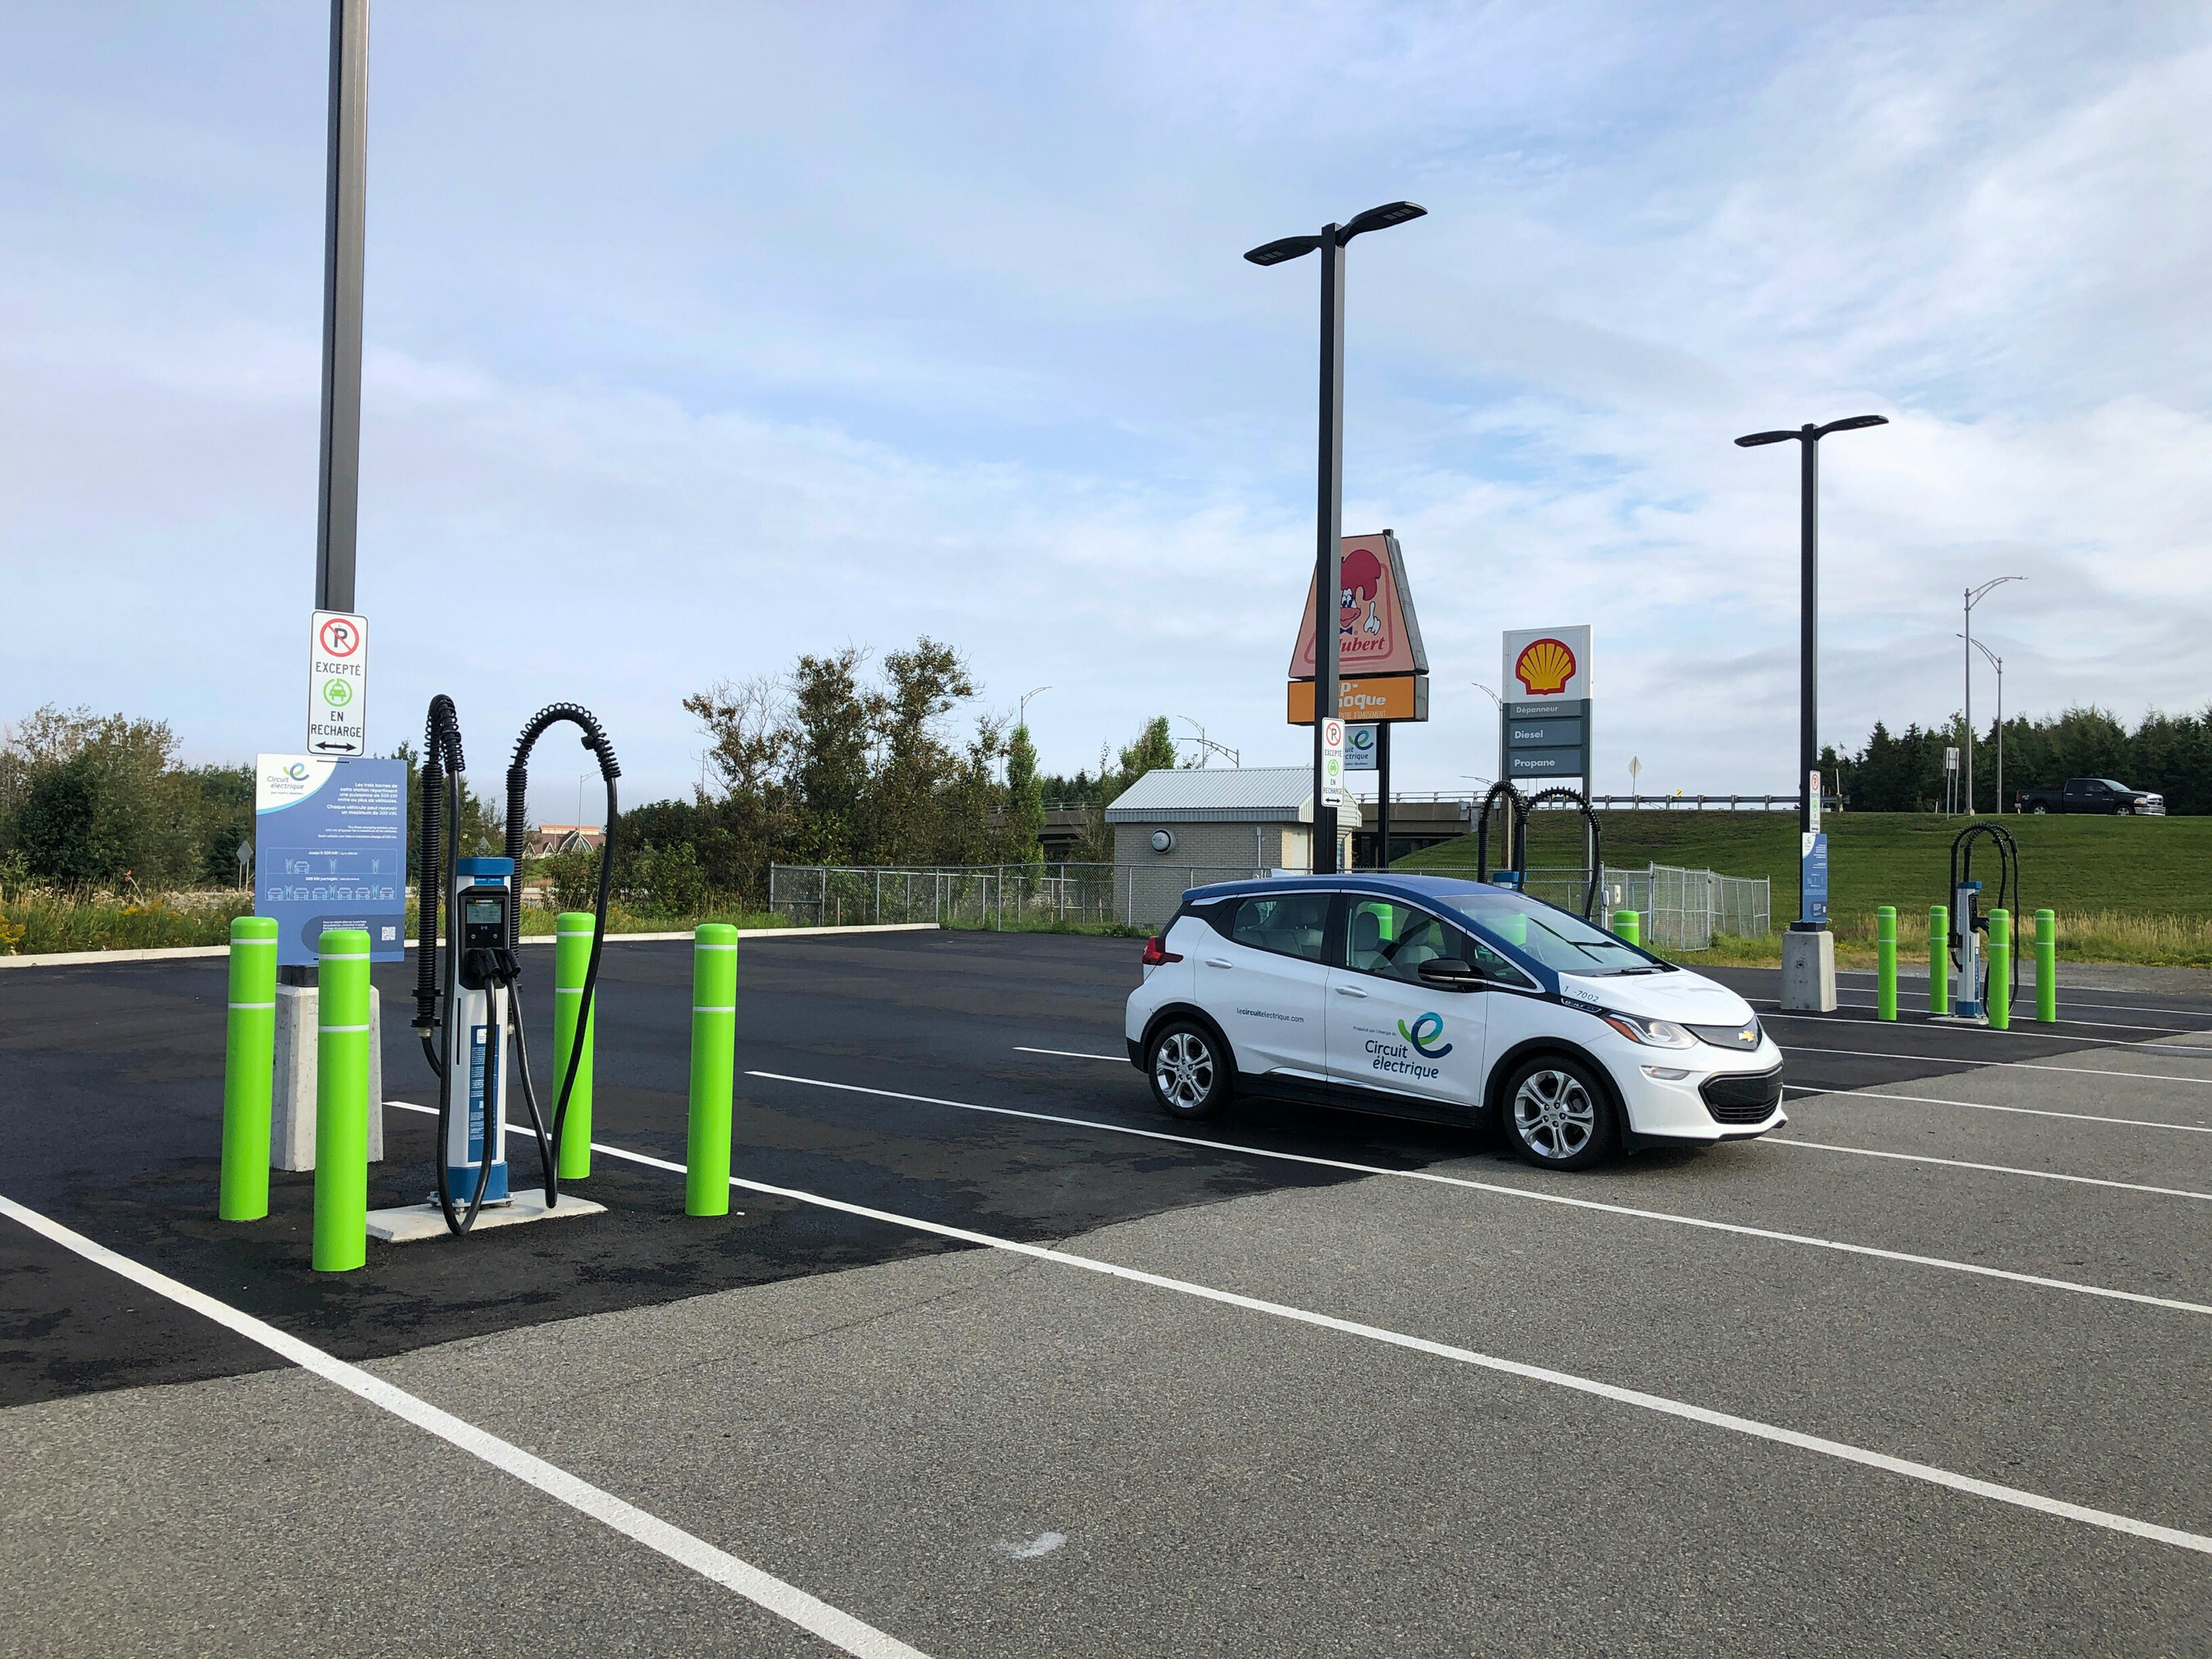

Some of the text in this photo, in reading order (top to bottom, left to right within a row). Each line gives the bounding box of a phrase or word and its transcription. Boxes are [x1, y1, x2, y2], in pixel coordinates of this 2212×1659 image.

[1339, 637, 1385, 652] ubert
[315, 661, 361, 676] EXCEPTÉ
[330, 710, 344, 722] EN
[1516, 706, 1559, 715] Dépanneur
[310, 724, 362, 737] RECHARGE
[1514, 729, 1543, 739] Diesel
[1514, 759, 1556, 769] Propane
[1236, 1007, 1304, 1022] lecircuitelectrique.com
[1365, 1040, 1408, 1058] Circuit
[1372, 1055, 1439, 1080] électrique
